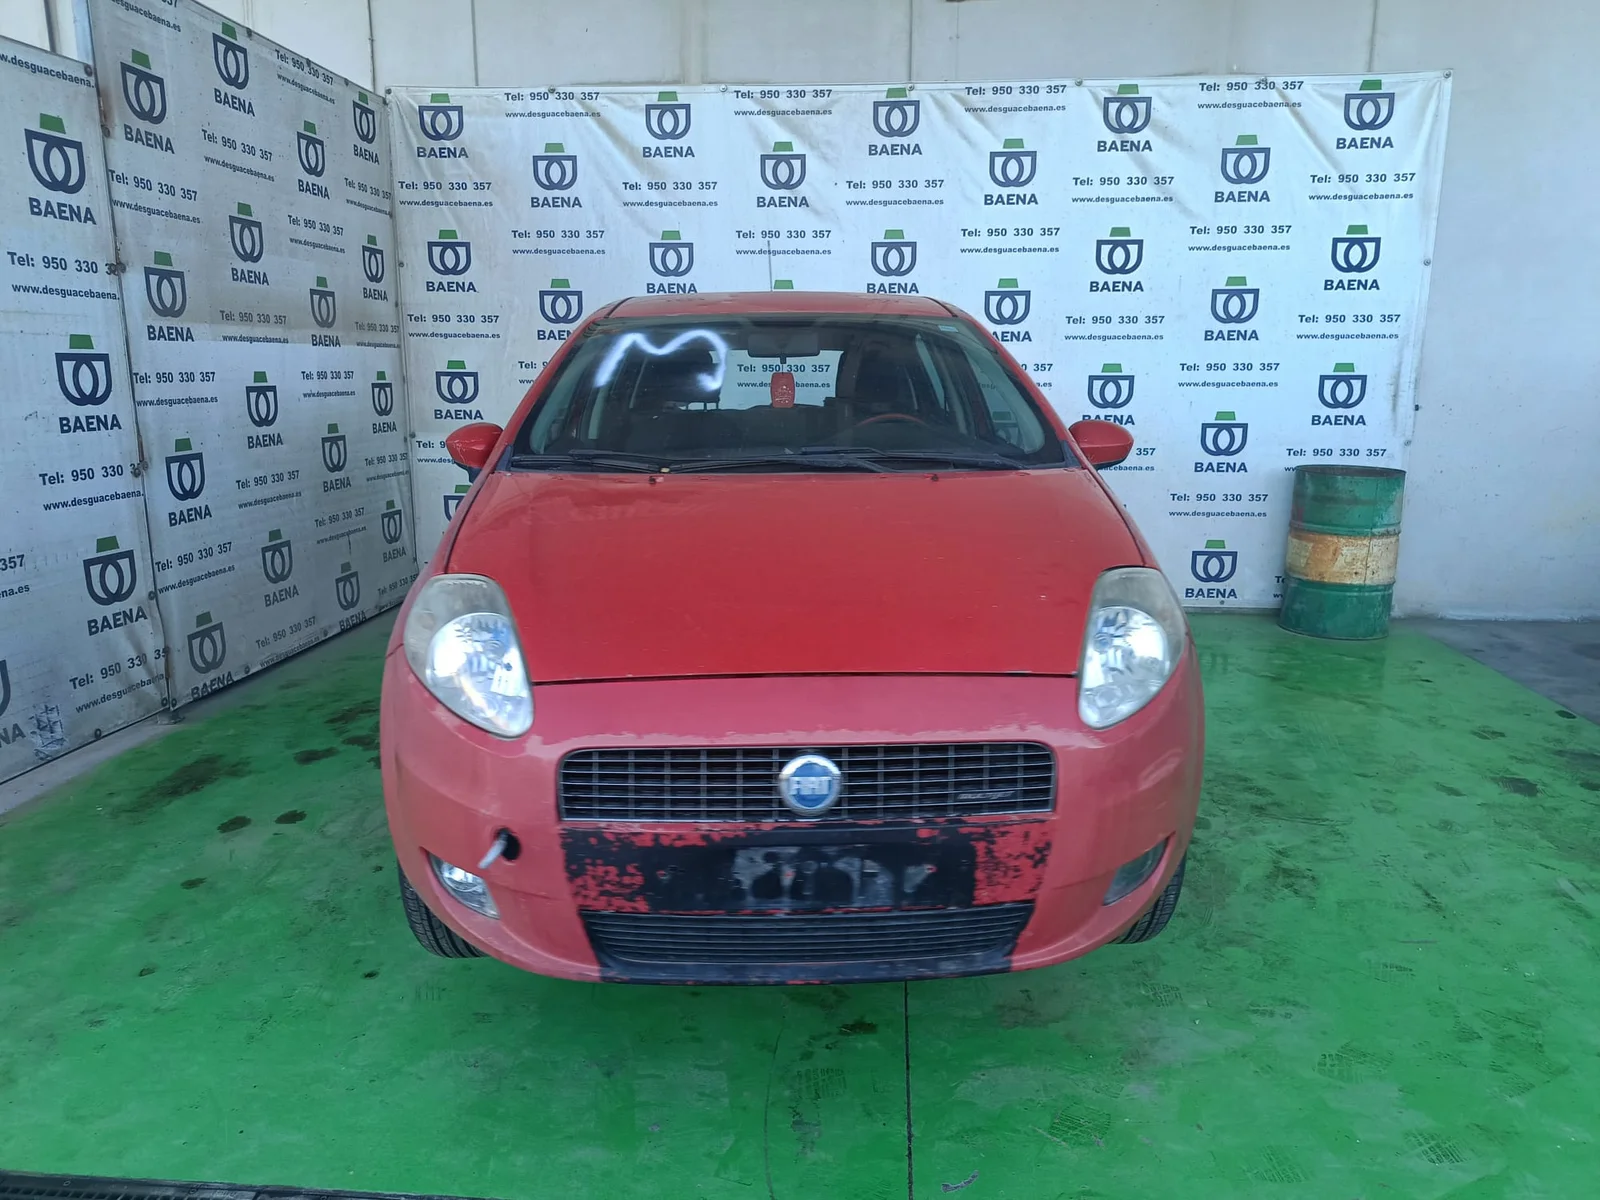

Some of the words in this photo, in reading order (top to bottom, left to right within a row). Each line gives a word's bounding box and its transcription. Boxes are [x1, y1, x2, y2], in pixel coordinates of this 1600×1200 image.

[1199, 82, 1220, 91] Tel:
[1227, 82, 1248, 91] 950
[1255, 82, 1276, 90] 330
[1282, 81, 1304, 90] 357
[504, 92, 524, 101] Tel:
[530, 92, 549, 100] 950
[555, 92, 574, 100] 330
[580, 92, 600, 100] 357
[734, 90, 754, 99] Tel:
[760, 90, 780, 98] 950
[786, 90, 806, 98] 330
[812, 89, 832, 98] 357
[214, 88, 255, 116] BAENA
[124, 124, 174, 154] BAENA
[1336, 136, 1394, 149] BAENA
[643, 146, 695, 158] BAENA
[868, 144, 922, 156] BAENA
[1097, 140, 1152, 152] BAENA
[354, 144, 380, 165] BAENA
[417, 147, 468, 158] BAENA
[1310, 175, 1331, 183] Tel:
[1338, 174, 1358, 183] 950
[1366, 174, 1386, 182] 330
[1394, 173, 1416, 182] 357
[134, 176, 152, 191] 950
[158, 182, 175, 196] 330
[180, 188, 197, 201] 357
[298, 179, 330, 200] BAENA
[398, 181, 418, 190] Tel:
[423, 181, 442, 190] 950
[449, 182, 467, 190] 330
[473, 182, 492, 190] 357
[846, 180, 866, 189] Tel:
[872, 180, 892, 189] 950
[898, 180, 918, 188] 330
[924, 180, 944, 188] 357
[757, 196, 810, 208] BAENA
[984, 194, 1038, 205] BAENA
[1214, 190, 1270, 202] BAENA
[531, 197, 582, 208] BAENA
[28, 197, 97, 225] BAENA
[536, 230, 555, 238] 950
[561, 230, 580, 238] 330
[586, 230, 604, 238] 357
[961, 228, 980, 237] Tel:
[987, 228, 1007, 236] 950
[1014, 228, 1033, 236] 330
[1040, 228, 1060, 236] 357
[42, 256, 67, 270] 950
[75, 260, 98, 274] 330
[231, 268, 269, 286] BAENA
[426, 281, 476, 292] BAENA
[646, 283, 697, 293] BAENA
[867, 283, 919, 294] BAENA
[1090, 281, 1144, 292] BAENA
[1324, 279, 1380, 290] BAENA
[12, 284, 120, 300] www.desguacebaena.
[363, 287, 388, 302] BAENA
[1066, 316, 1085, 324] Tel:
[1092, 316, 1112, 324] 950
[1118, 316, 1138, 324] 330
[1145, 316, 1165, 324] 357
[147, 324, 194, 342] BAENA
[993, 331, 1032, 342] AENA
[1204, 330, 1259, 341] BAENA
[311, 334, 341, 347] BAENA
[737, 364, 756, 372] Tel:
[762, 364, 780, 373] 950
[787, 364, 805, 373] 330
[1206, 363, 1226, 371] 950
[1233, 363, 1253, 371] 330
[1260, 363, 1280, 371] 357
[156, 372, 173, 383] 950
[178, 372, 195, 382] 330
[200, 372, 215, 382] 357
[434, 409, 484, 420] BAENA
[1312, 415, 1366, 426] BAENA
[59, 414, 122, 434] BAENA
[372, 421, 397, 434] BAENA
[248, 433, 283, 449] BAENA
[1194, 462, 1248, 472] BAENA
[323, 476, 351, 492] BAENA
[43, 490, 144, 512] www.desguacebaena.
[168, 504, 212, 527] BAENA
[178, 552, 193, 566] 950
[198, 547, 213, 560] 330
[218, 542, 232, 554] 357
[383, 546, 406, 562] BAENA
[264, 584, 299, 607] BAENA
[1185, 588, 1237, 598] BAENA
[87, 606, 148, 636] BAENA
